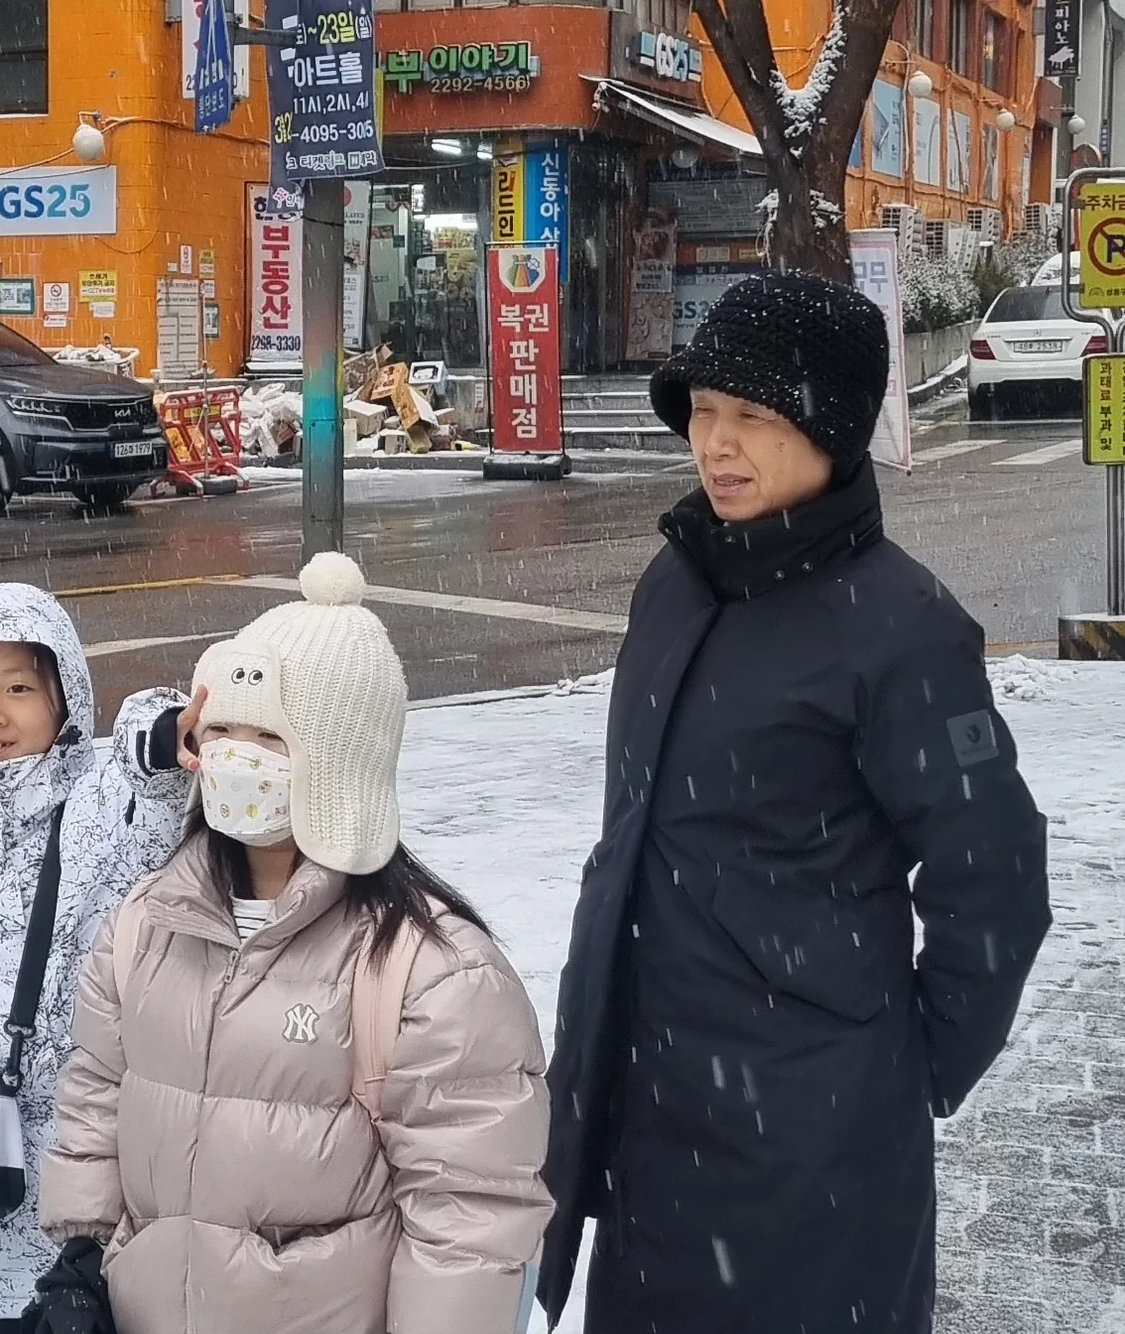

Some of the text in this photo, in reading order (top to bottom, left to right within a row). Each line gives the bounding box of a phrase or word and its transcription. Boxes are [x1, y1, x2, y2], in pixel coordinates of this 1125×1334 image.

[293, 51, 364, 88] 아트홀
[383, 49, 423, 93] 부
[655, 32, 689, 83] GS25
[540, 153, 561, 223] 신동아
[261, 225, 292, 330] 부동산
[497, 302, 550, 334] 복권
[508, 338, 540, 440] 판매점
